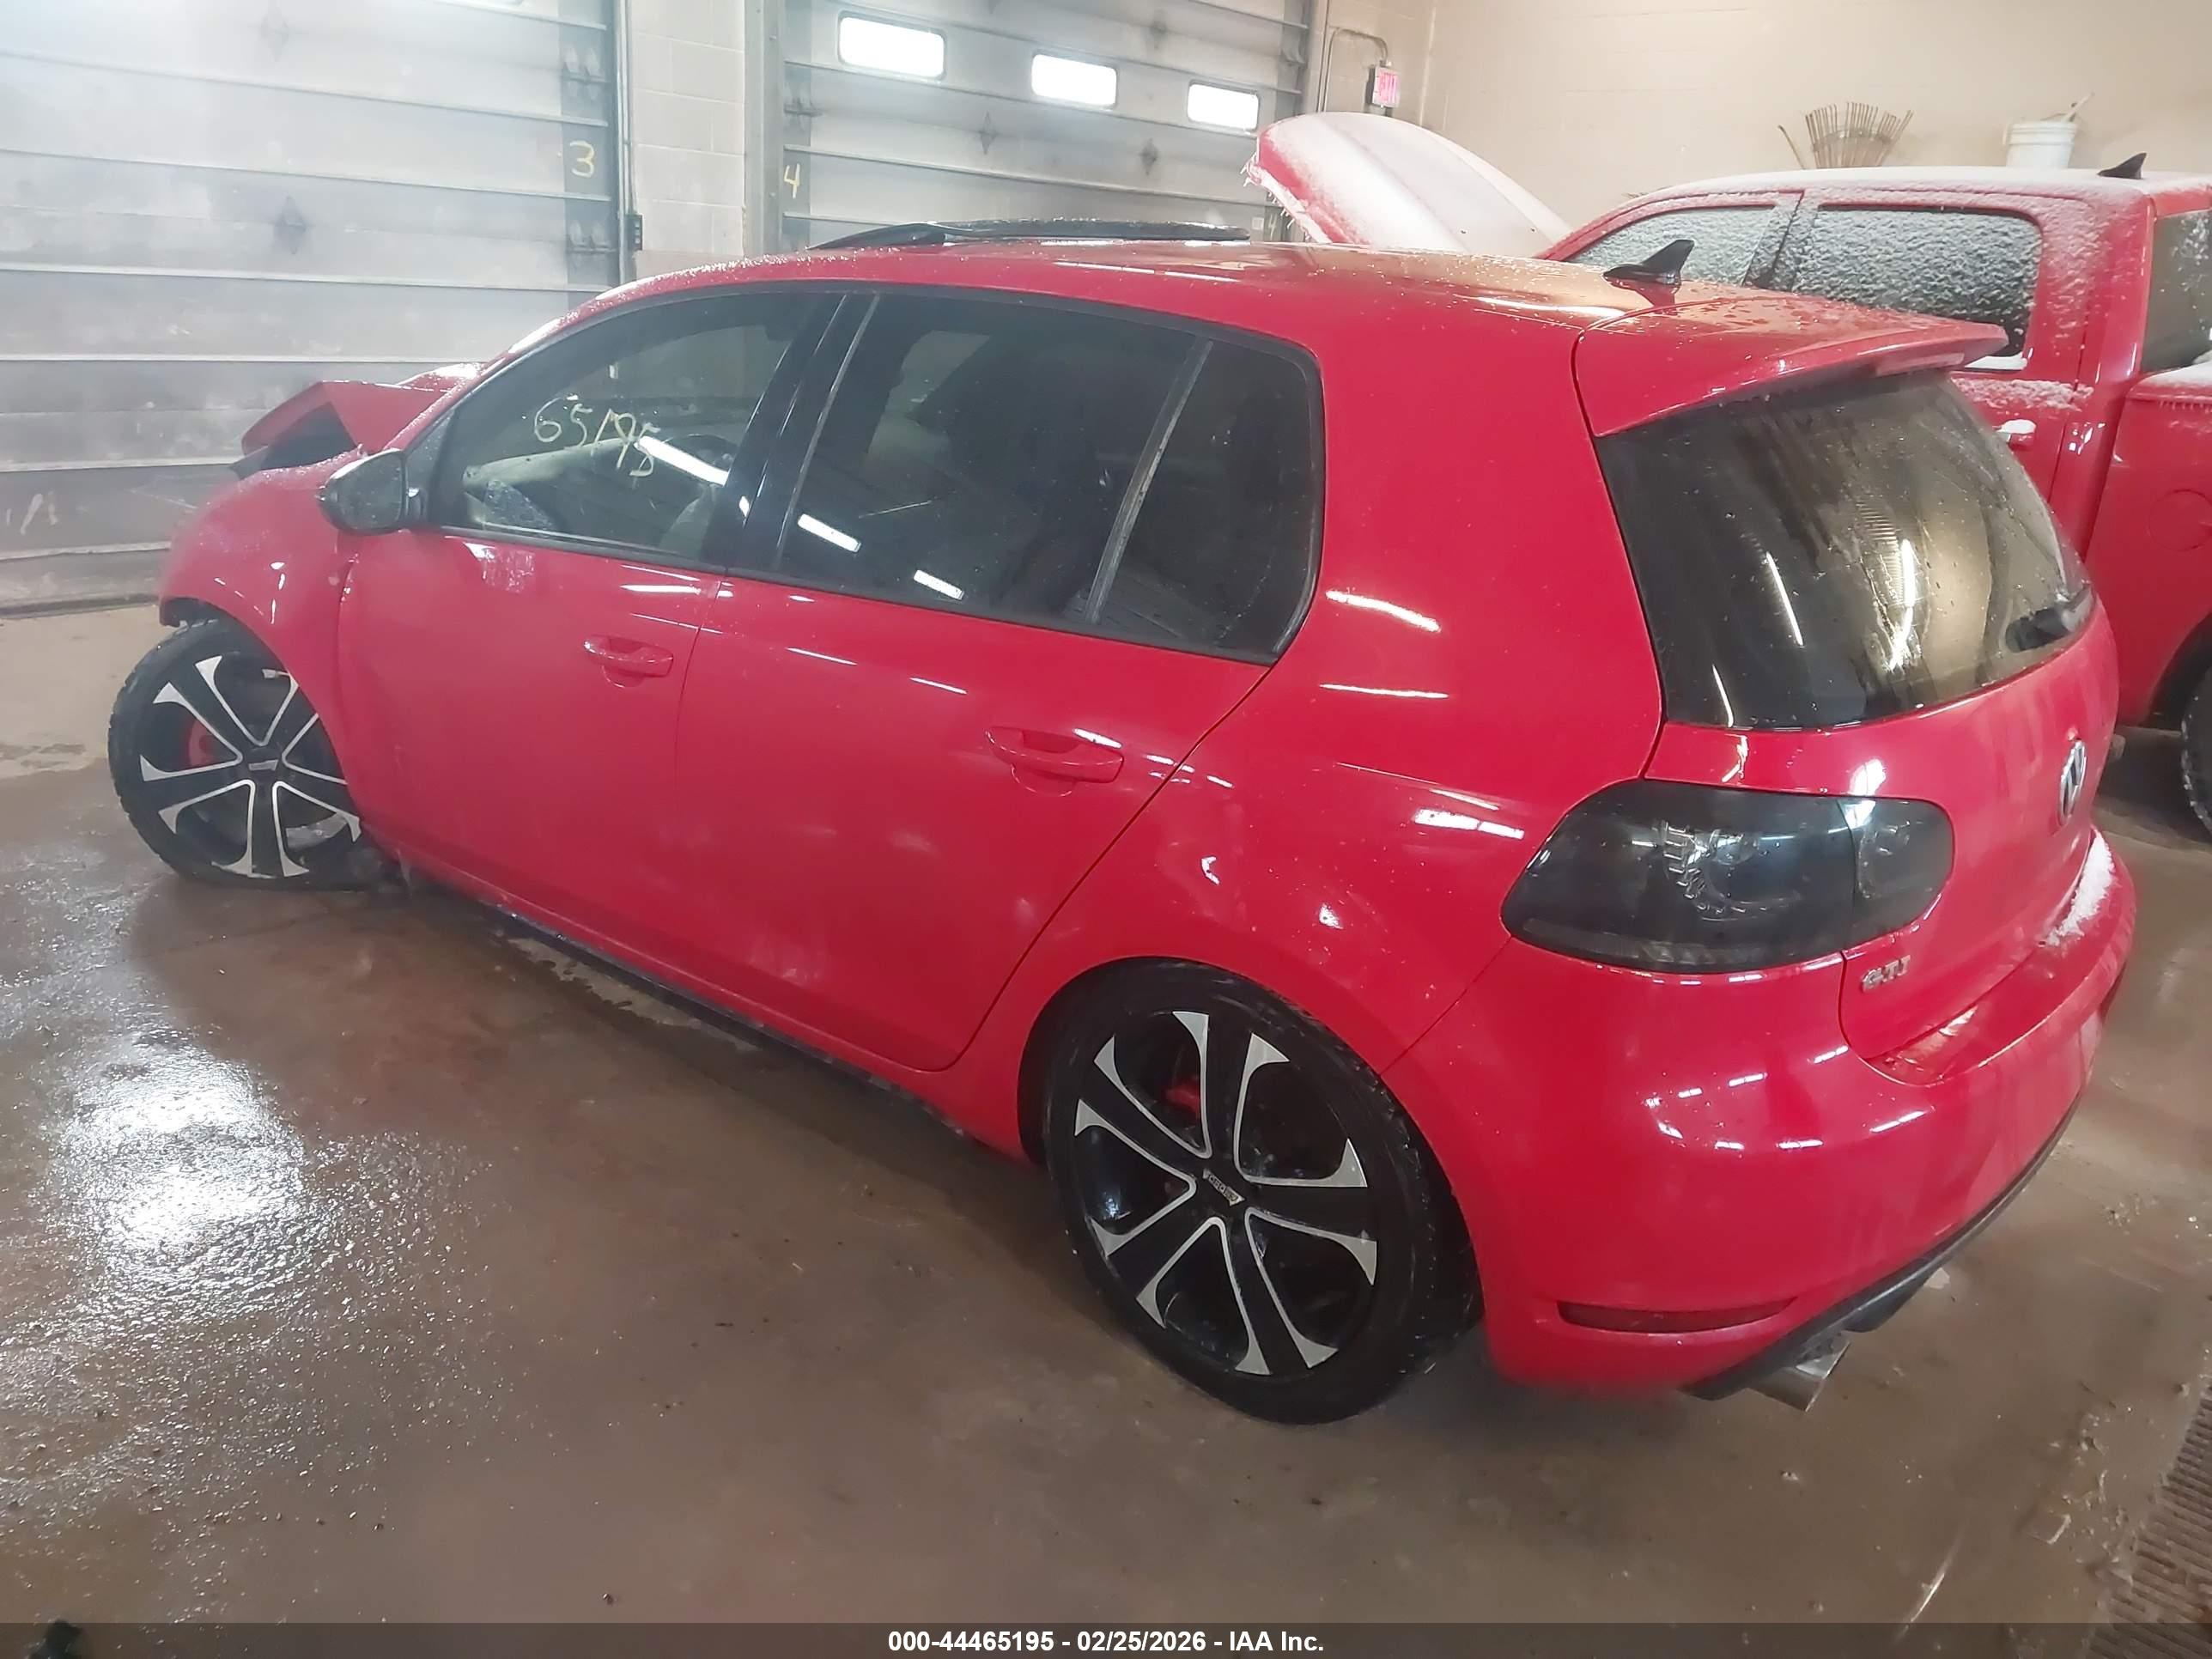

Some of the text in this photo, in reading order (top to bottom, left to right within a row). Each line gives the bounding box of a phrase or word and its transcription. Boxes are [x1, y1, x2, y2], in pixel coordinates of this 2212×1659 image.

[569, 141, 594, 178] 3
[783, 163, 800, 199] 4
[1863, 955, 1911, 990] GTI
